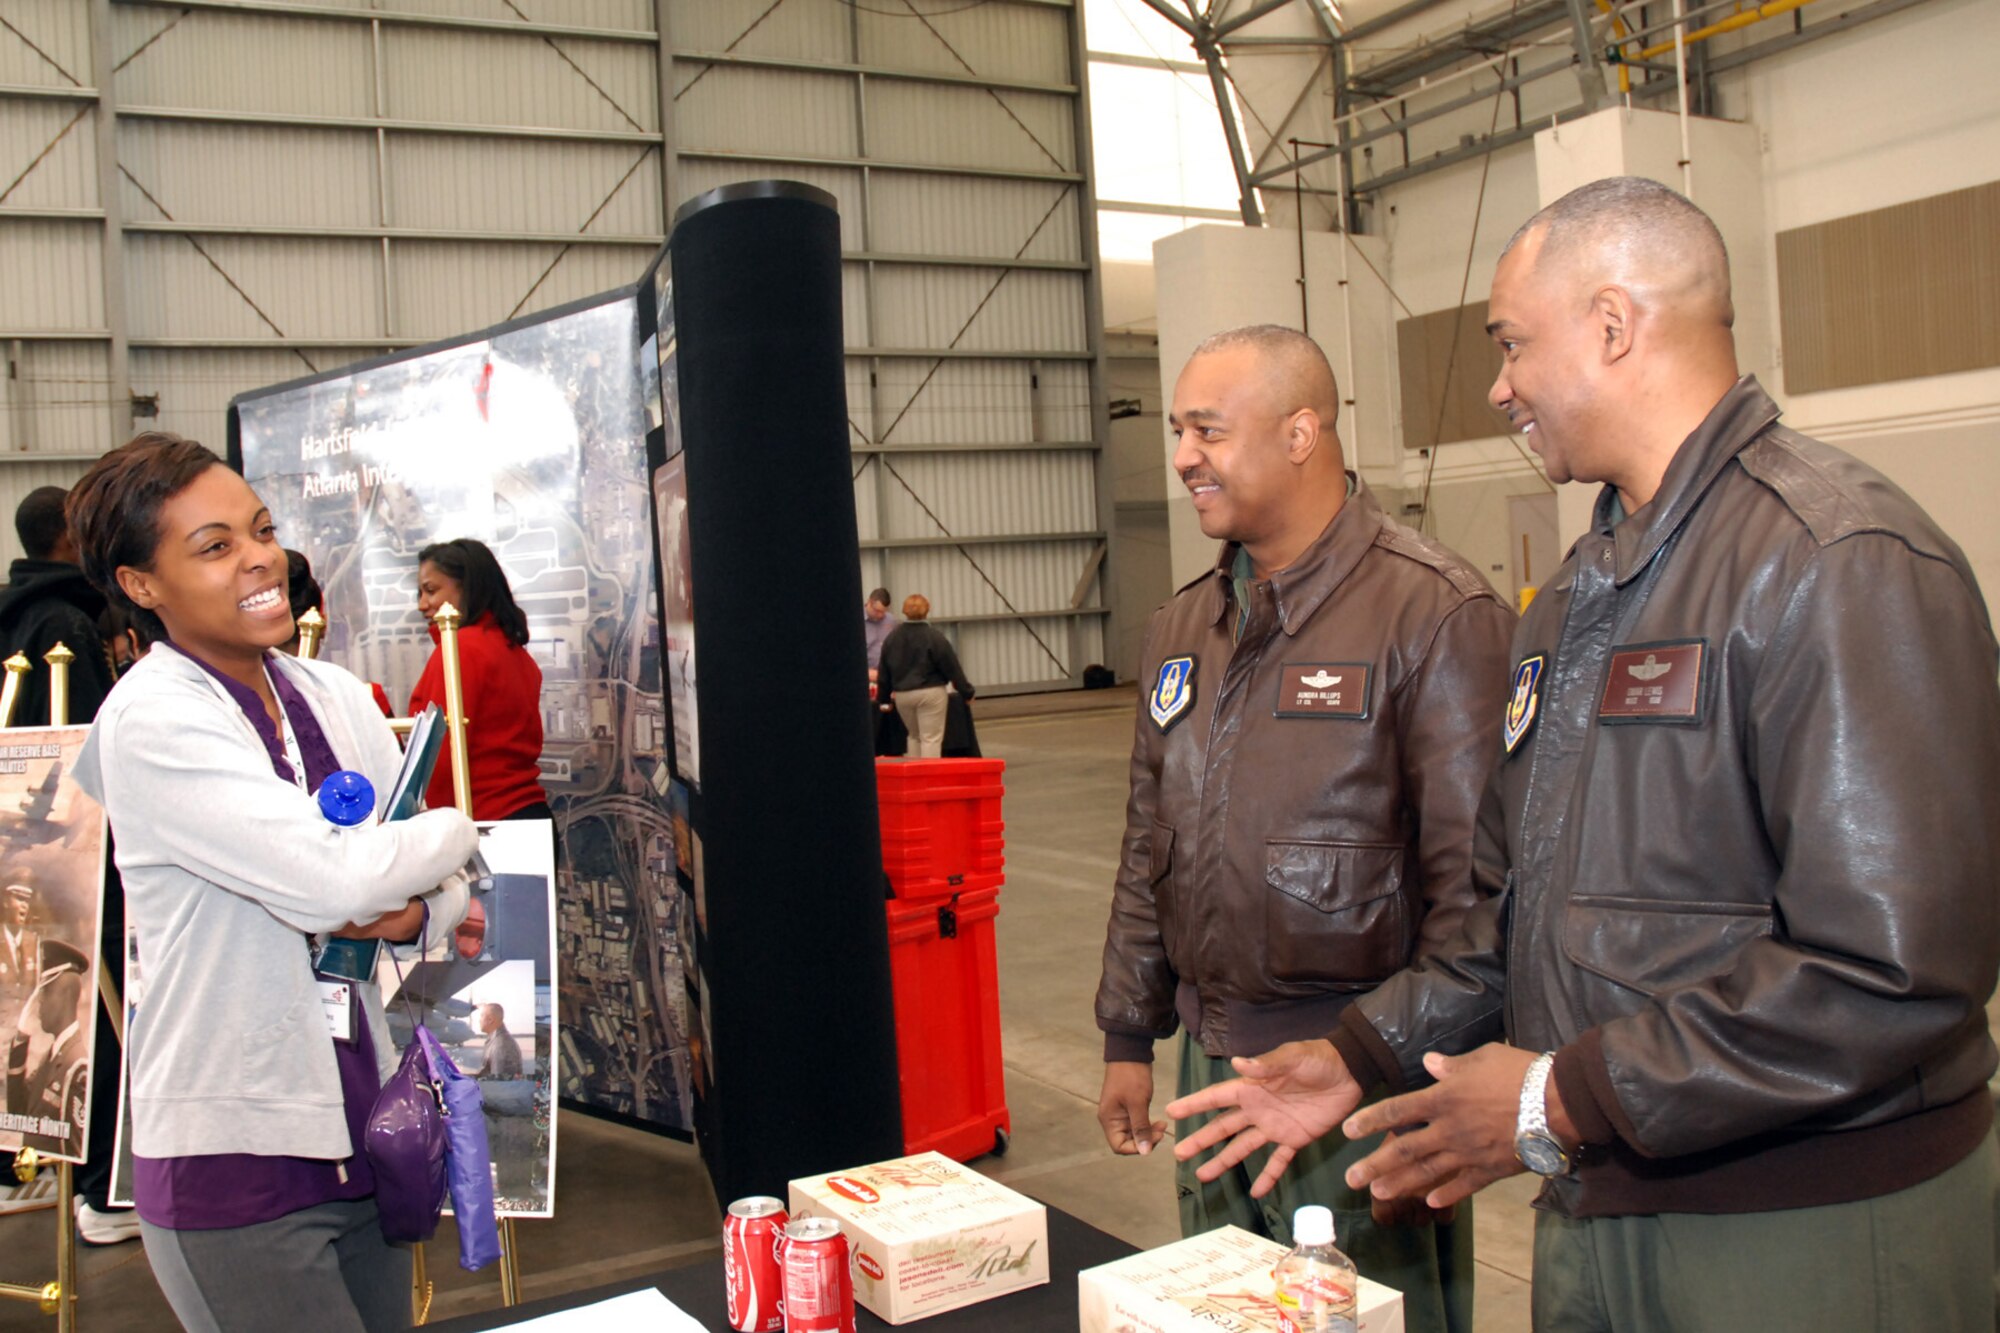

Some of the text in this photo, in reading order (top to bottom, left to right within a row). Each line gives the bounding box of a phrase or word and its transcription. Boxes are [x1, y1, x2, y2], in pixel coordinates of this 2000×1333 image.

[301, 421, 379, 460] Hartsfi
[303, 470, 358, 499] Atlanta
[9, 745, 41, 759] RESERVE
[41, 744, 60, 758] BASE
[39, 1116, 71, 1139] MONTH
